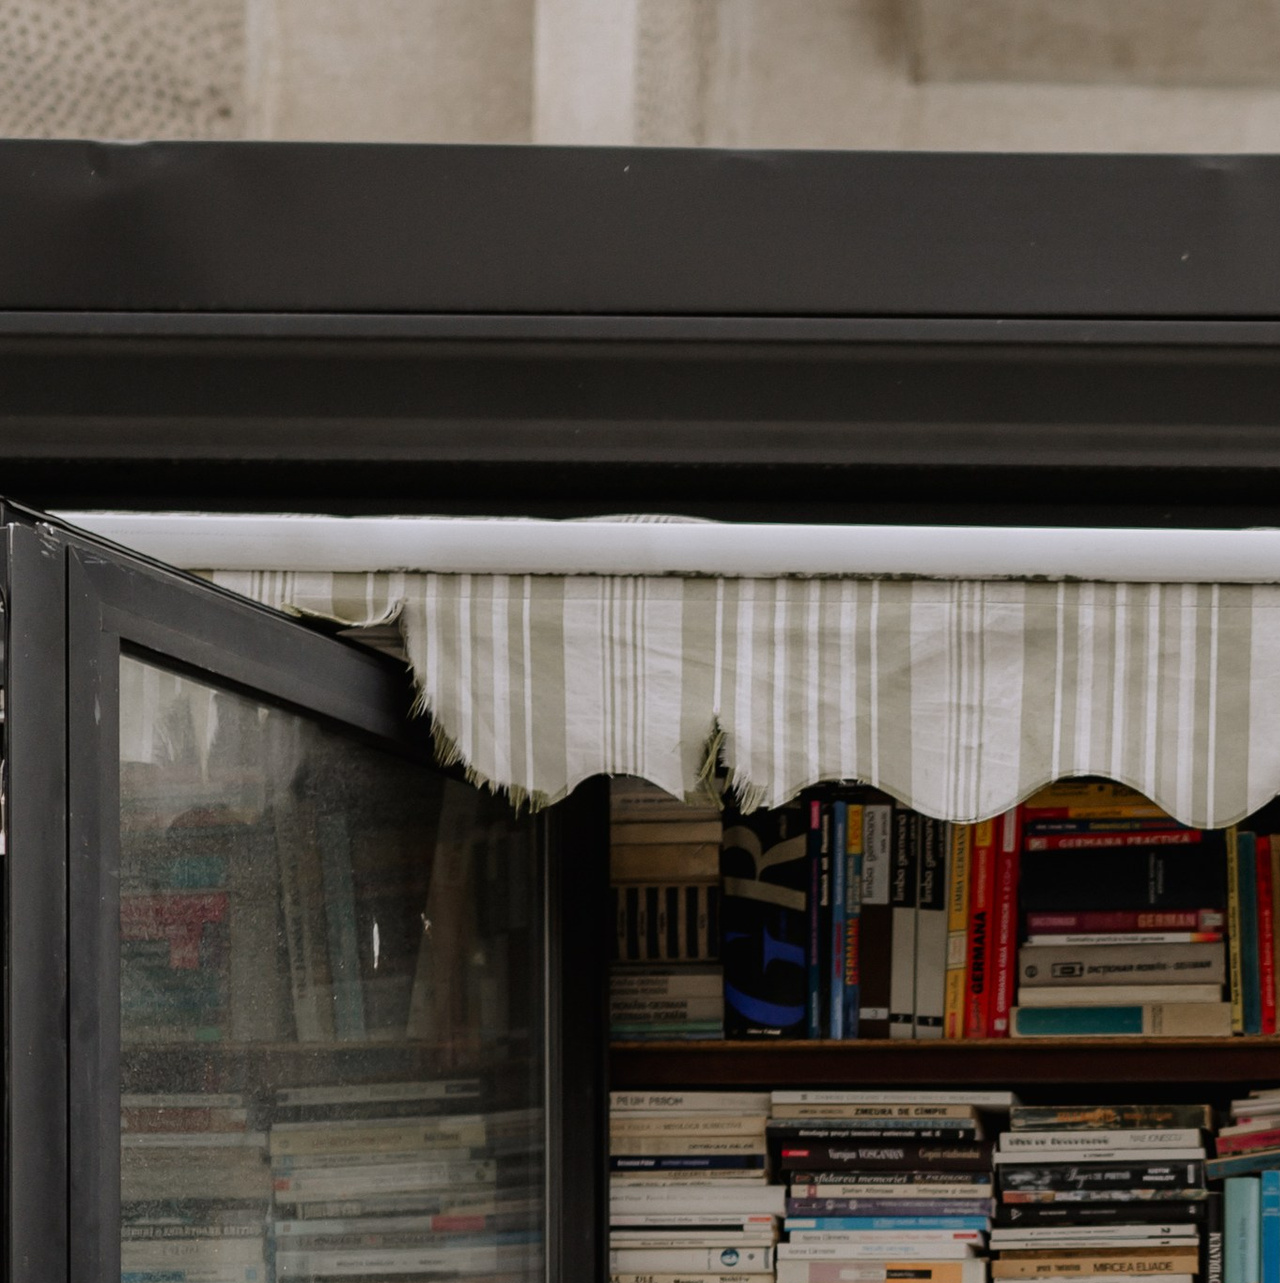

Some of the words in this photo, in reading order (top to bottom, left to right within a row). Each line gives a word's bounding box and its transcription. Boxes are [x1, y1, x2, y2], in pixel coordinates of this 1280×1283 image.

[970, 911, 987, 993] GERMANA
[1093, 1262, 1134, 1273] MIRCEA
[1136, 1261, 1174, 1272] ELIADE
